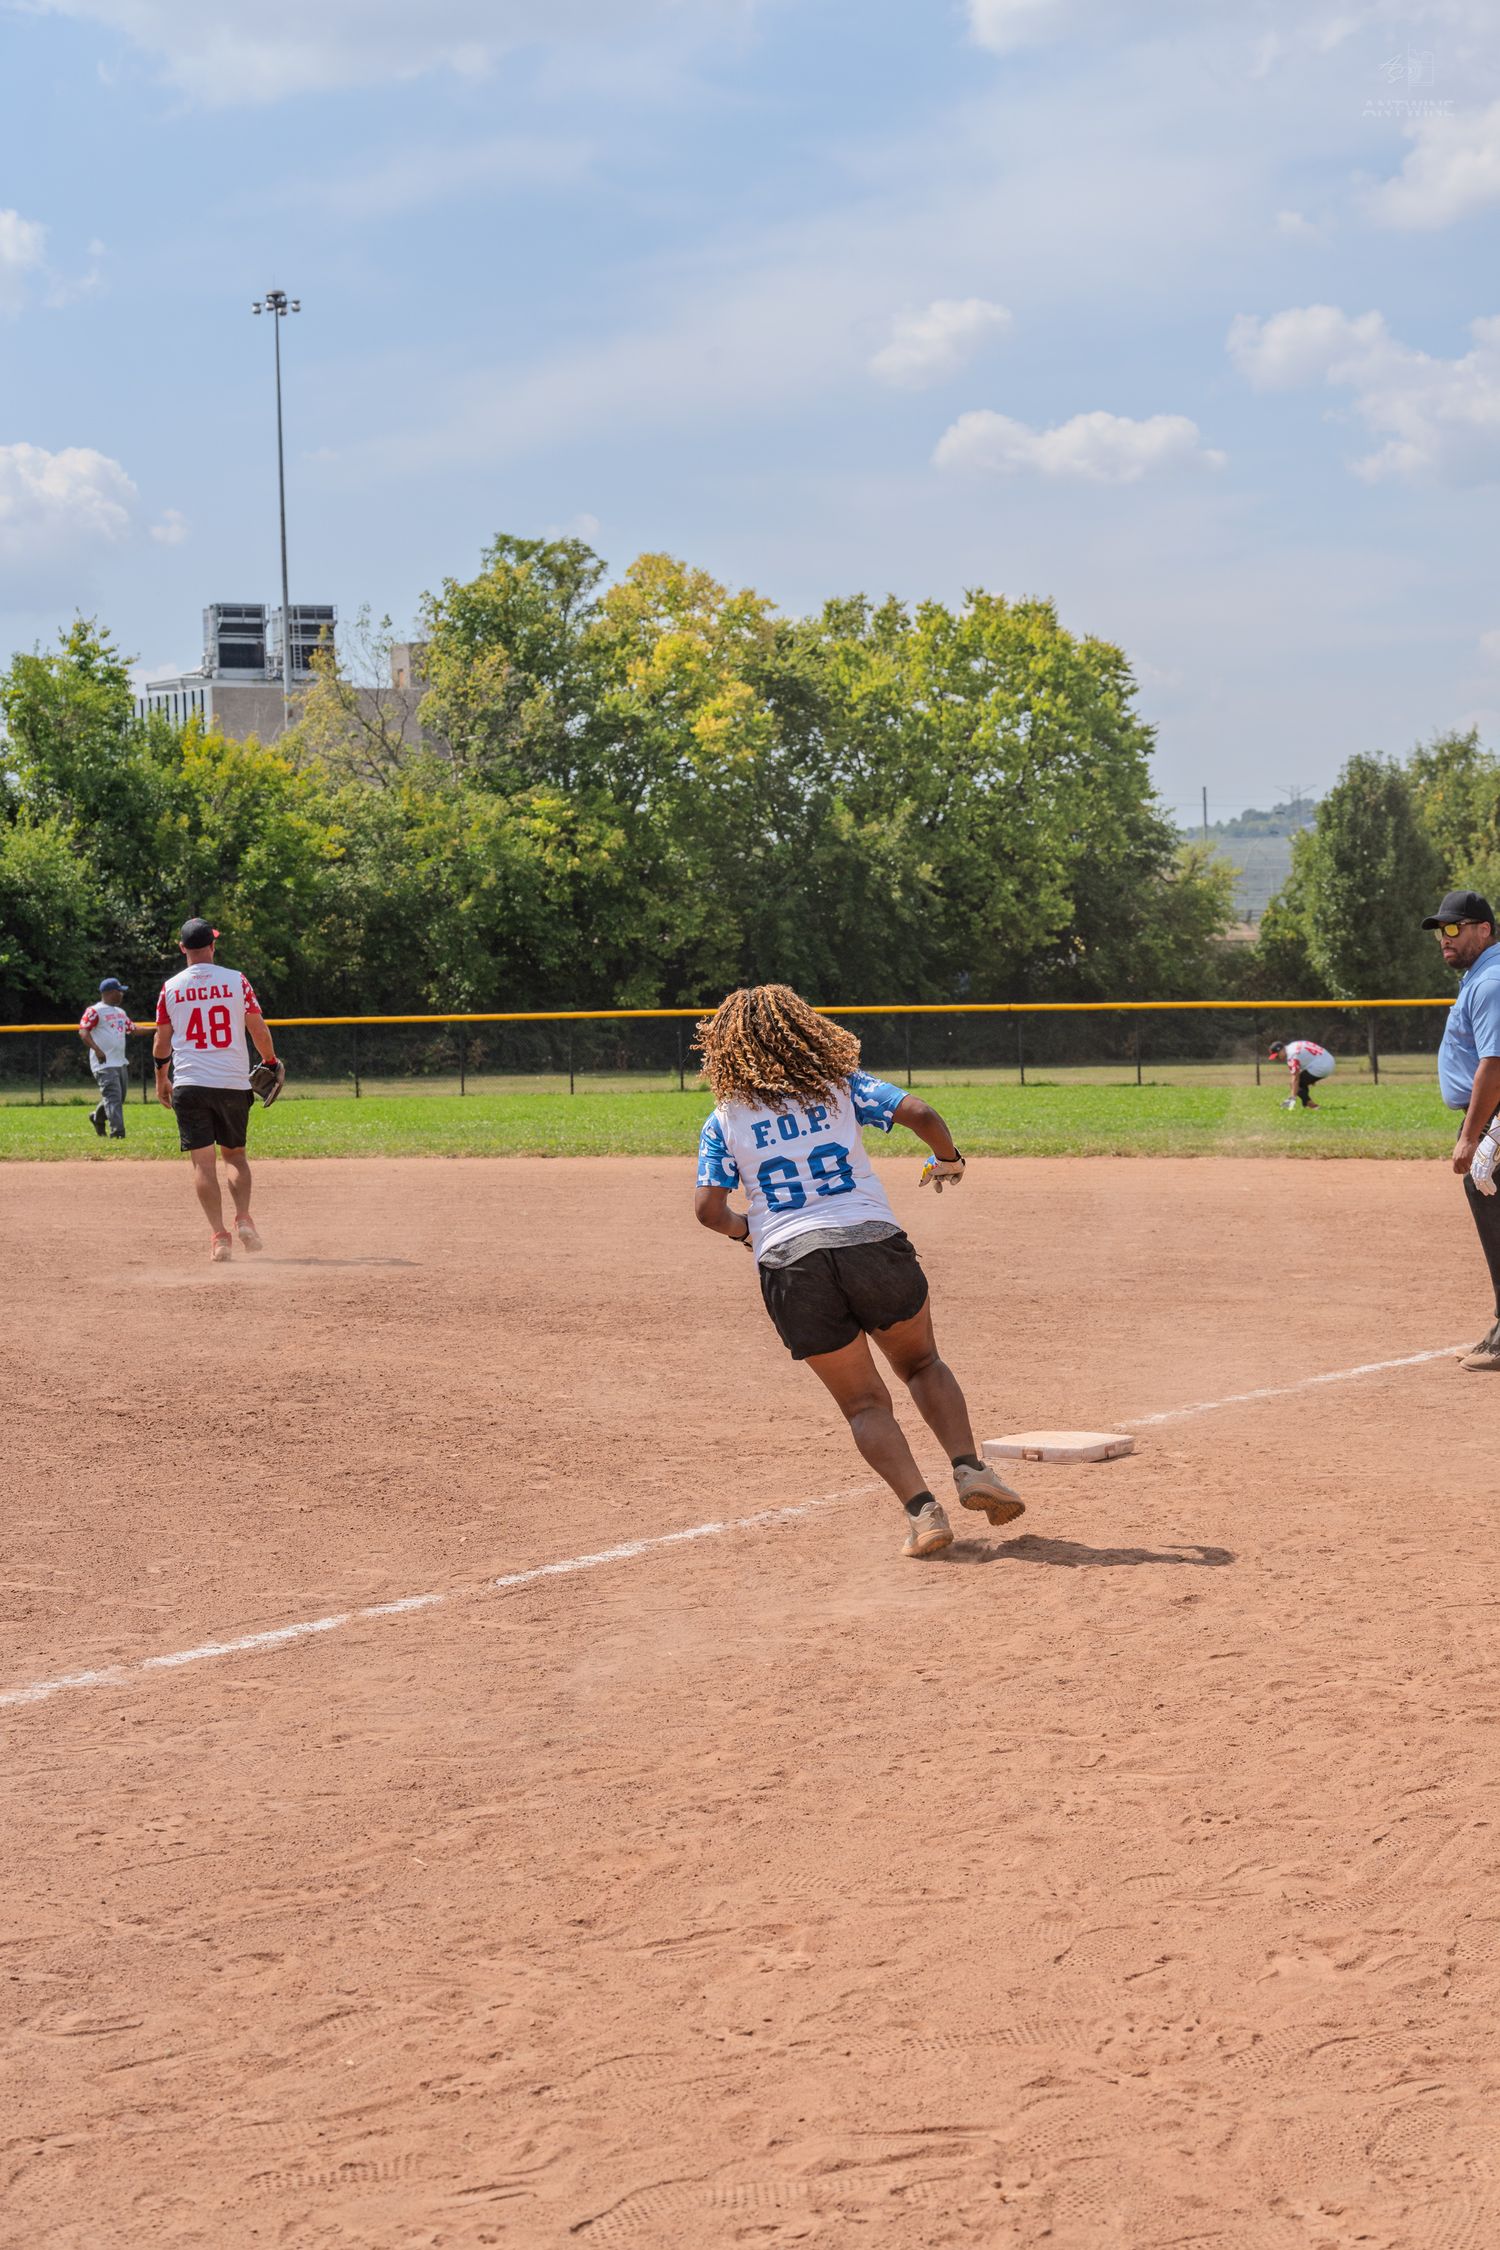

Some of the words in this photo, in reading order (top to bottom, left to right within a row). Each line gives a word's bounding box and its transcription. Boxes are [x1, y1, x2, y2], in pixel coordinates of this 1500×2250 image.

[174, 984, 233, 1003] LOCAL
[186, 1005, 232, 1049] 48
[751, 1105, 831, 1149] F.O.P.
[757, 1141, 856, 1212] 69
